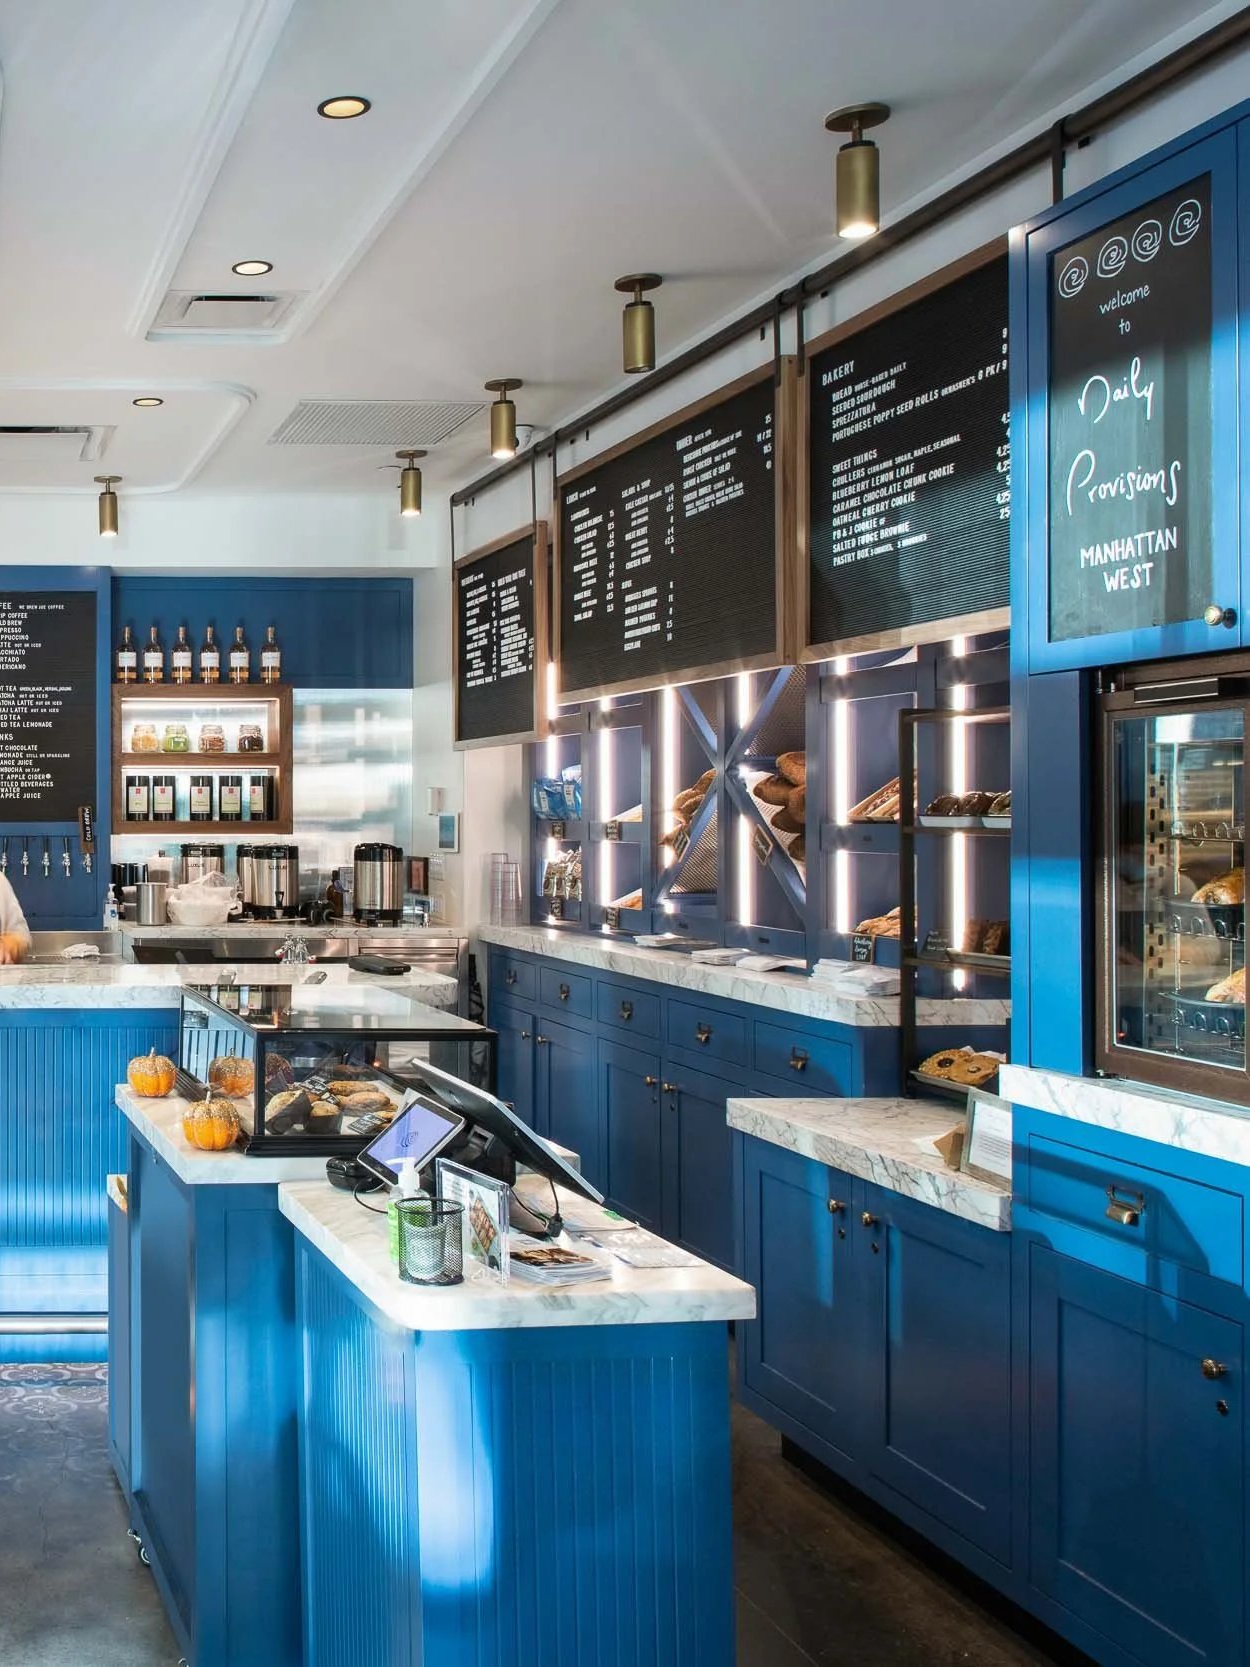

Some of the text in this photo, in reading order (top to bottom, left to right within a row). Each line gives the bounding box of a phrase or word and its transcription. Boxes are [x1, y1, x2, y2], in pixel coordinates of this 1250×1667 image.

[1099, 283, 1151, 315] welcome
[1118, 318, 1131, 336] to
[822, 360, 854, 386] BAKERY
[832, 328, 1007, 416] SEEDED SOURDOUGH 9
[832, 344, 1007, 429] SPREZZATURA 9
[832, 385, 852, 402] BREAD
[832, 360, 1006, 442] PORTUGUESE POPPY SEED ROLLS 9
[1078, 356, 1155, 424] Daily
[832, 449, 877, 474] SWEET THINGS
[832, 468, 865, 487] CRULLERS
[832, 480, 868, 500] BLUEBERRY
[871, 471, 894, 486] LEMON
[896, 463, 914, 478] LOAF
[832, 496, 861, 514] CARAMEL
[863, 482, 901, 503] CHOCOLATE
[903, 473, 926, 489] CHUNK
[928, 463, 954, 481] COOKIE
[1066, 449, 1182, 516] Provisions
[832, 510, 860, 527] OATMEAL
[862, 500, 889, 517] CHERRY
[890, 491, 916, 508] COOKIE
[832, 530, 841, 540] PB
[842, 528, 847, 537] &
[848, 526, 852, 535] J
[853, 518, 878, 533] COOKIE
[832, 538, 856, 553] SALTED
[857, 532, 878, 546] FUDGE
[879, 522, 910, 539] BROWNIE
[832, 552, 855, 566] PASTRY
[856, 548, 869, 560] BOX
[1079, 526, 1178, 569] MANHATTAN
[1101, 561, 1154, 593] WEST
